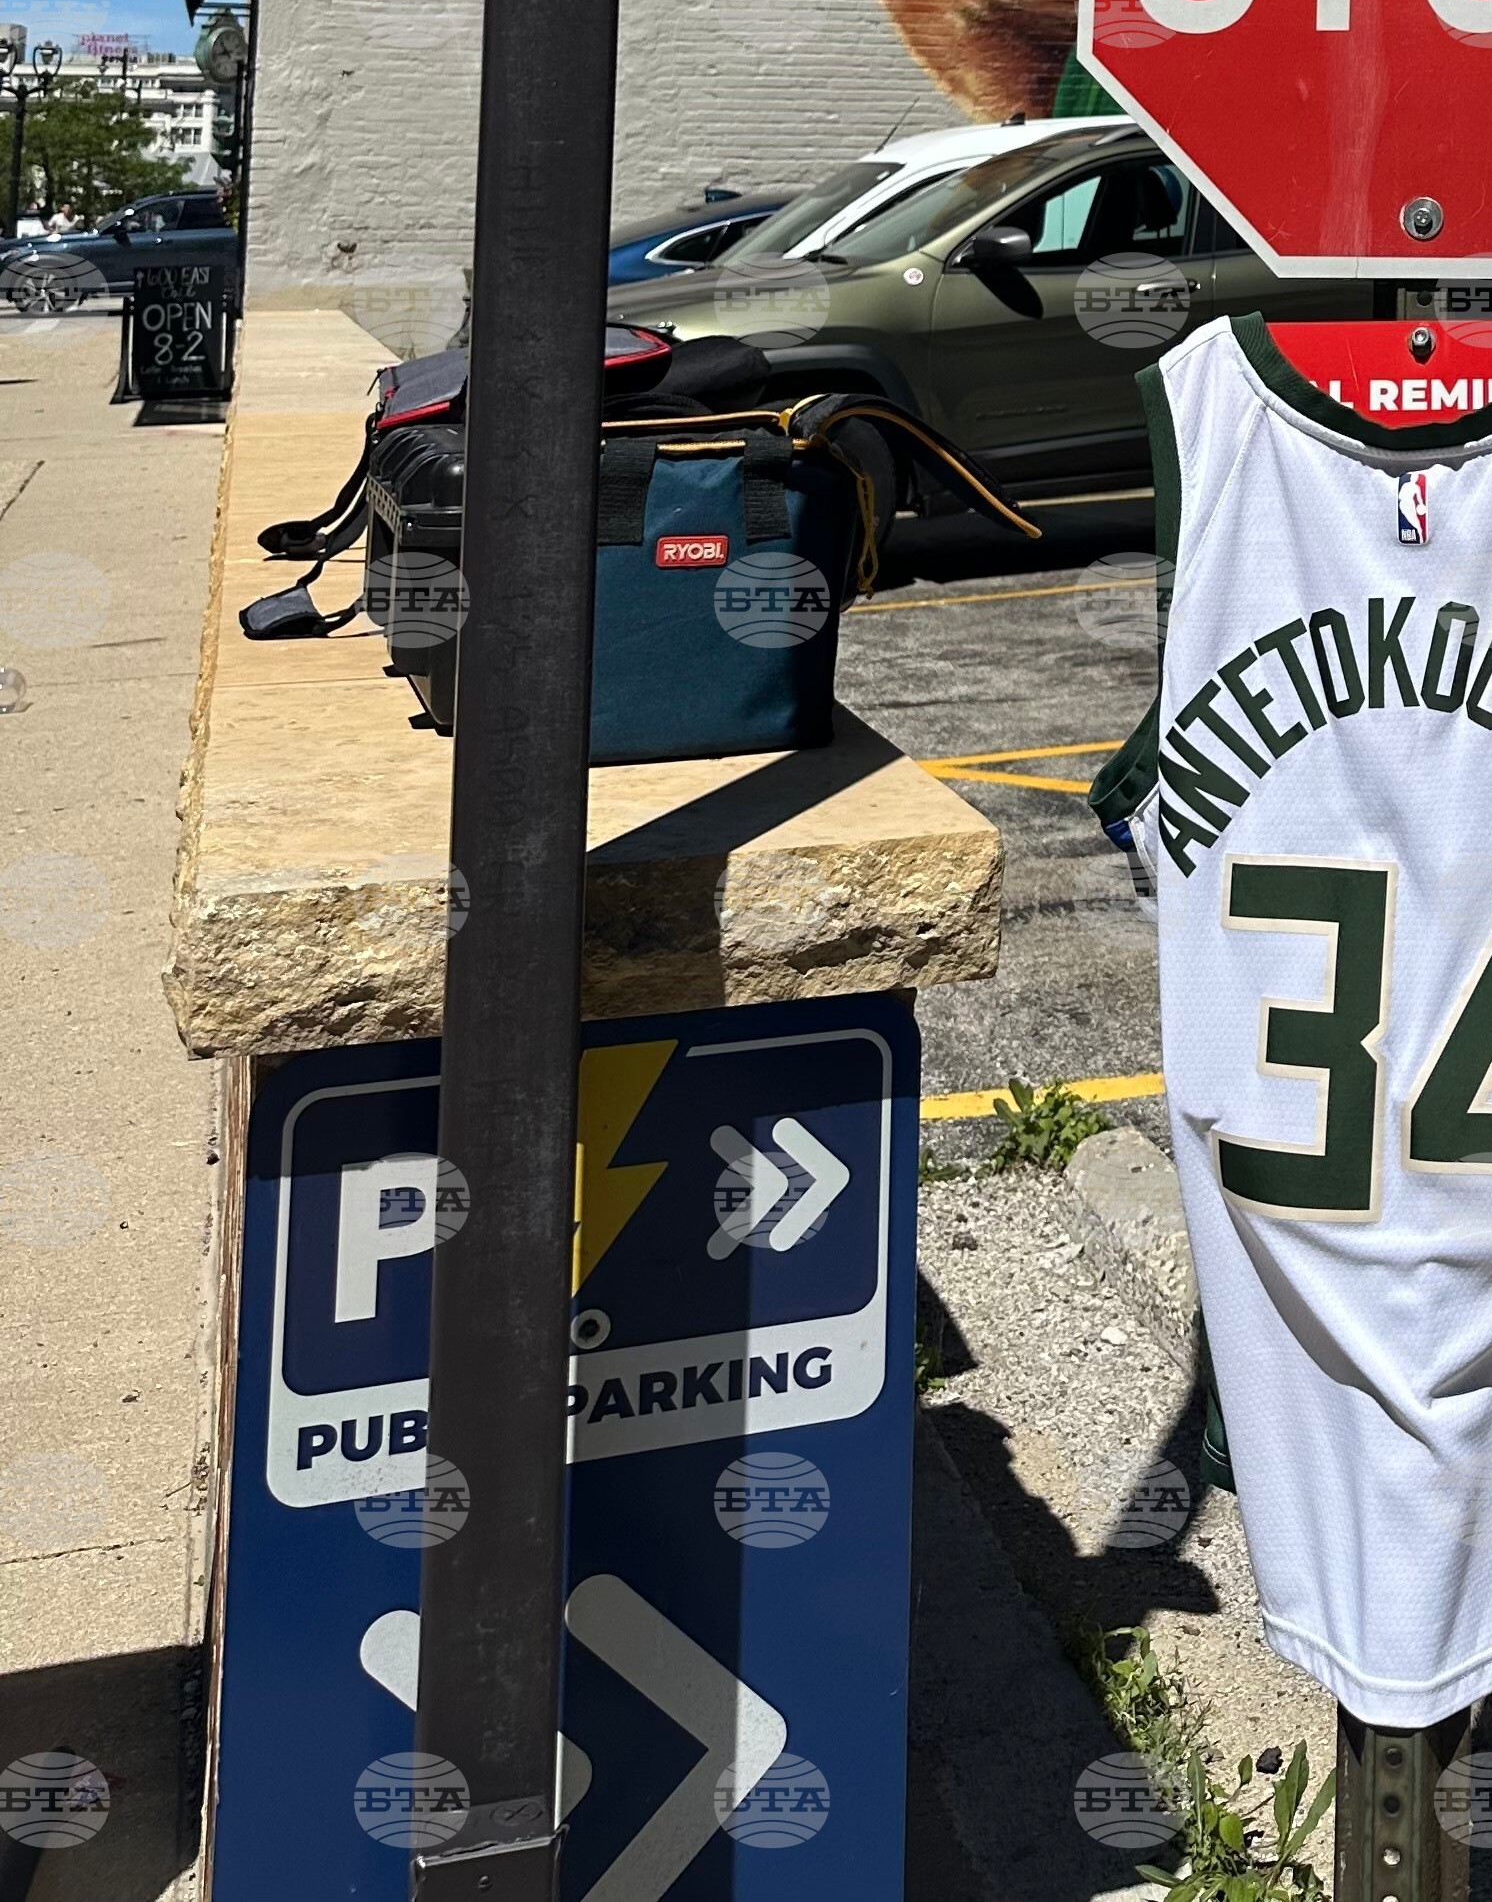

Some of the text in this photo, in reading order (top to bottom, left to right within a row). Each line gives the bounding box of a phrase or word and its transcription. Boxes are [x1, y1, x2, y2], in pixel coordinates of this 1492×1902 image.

[81, 32, 129, 45] planet
[181, 266, 211, 285] EAST
[142, 301, 213, 332] OPEN
[153, 330, 206, 366] 8-2
[1401, 528, 1417, 541] NBA
[334, 1157, 438, 1324] P
[297, 1407, 428, 1472] PUB
